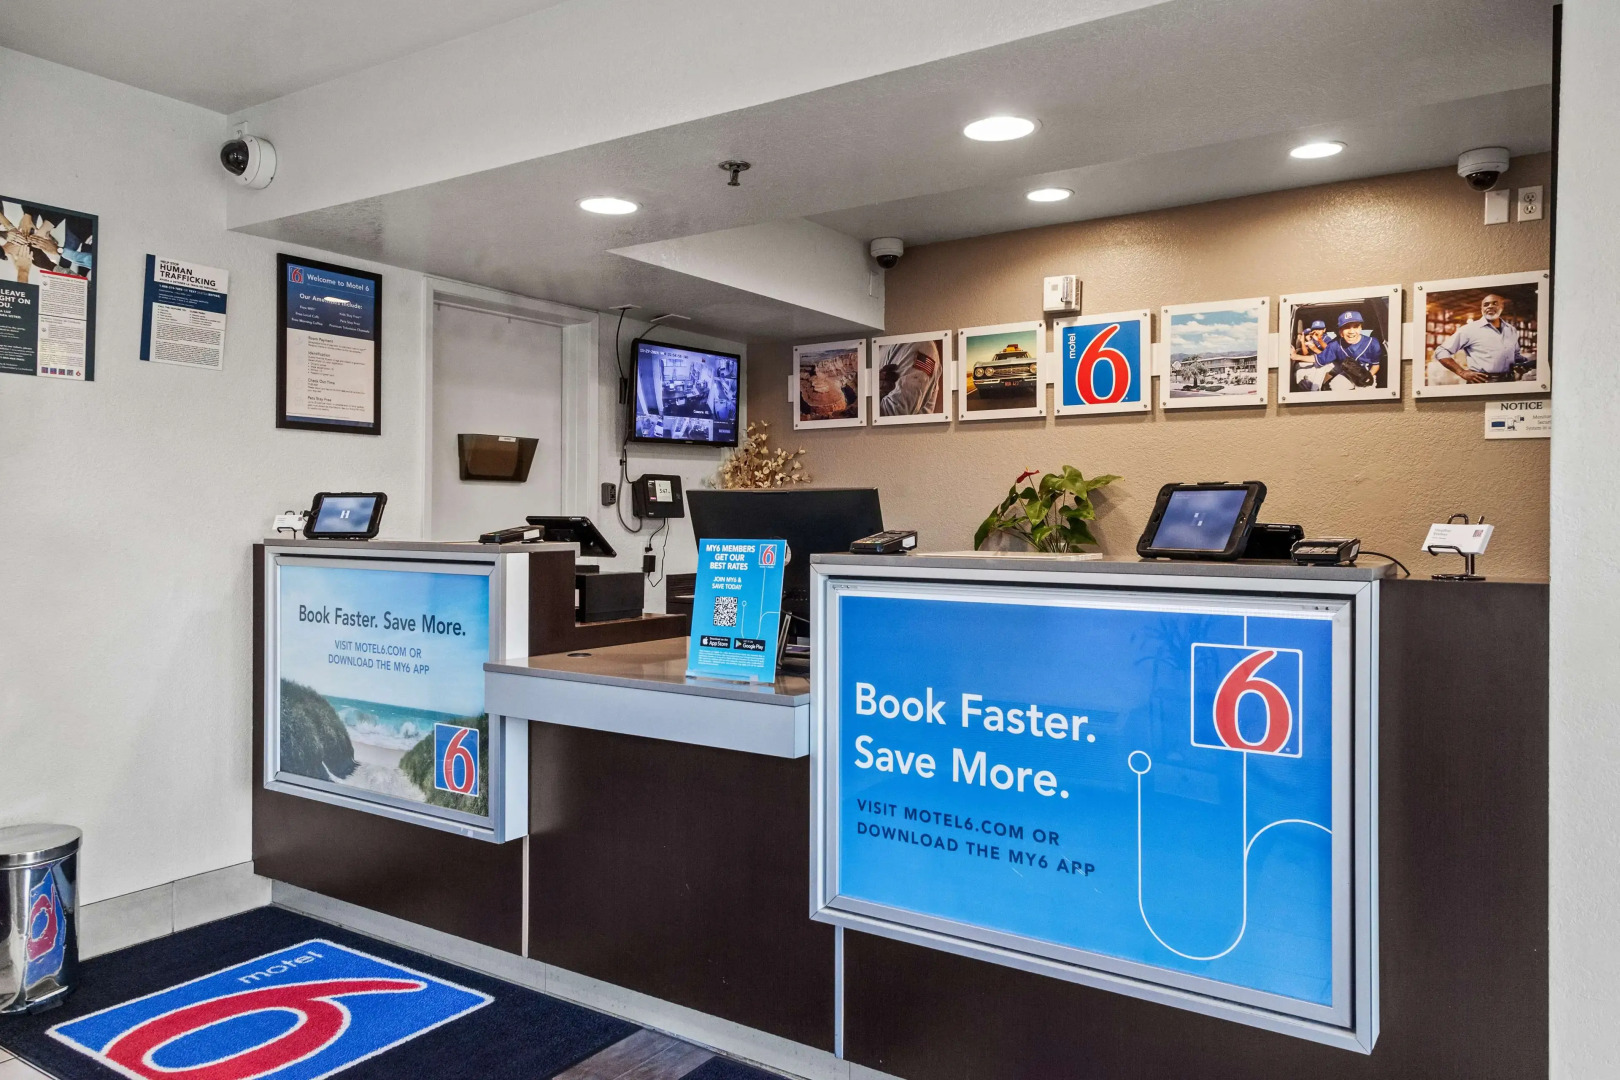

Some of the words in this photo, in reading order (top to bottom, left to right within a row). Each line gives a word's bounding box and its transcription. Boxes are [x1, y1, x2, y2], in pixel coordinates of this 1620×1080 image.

[160, 264, 192, 275] HUMAN
[160, 271, 216, 286] TRAFFICKING
[307, 273, 336, 285] Welcome
[346, 282, 363, 291] Motel
[0, 289, 25, 297] LEAVE
[1076, 323, 1131, 405] 6
[1501, 402, 1543, 411] NOTICE
[728, 562, 748, 570] RATES
[762, 545, 775, 565] 6
[298, 604, 330, 624] Book
[334, 607, 377, 629] Faster.
[383, 611, 416, 632] Save
[422, 614, 466, 636] More.
[328, 654, 373, 668] DOWNLOAD
[376, 659, 391, 670] THE
[393, 661, 411, 673] MY6
[413, 664, 429, 675] APP
[334, 639, 352, 650] VISIT
[354, 641, 407, 657] MOTEL6.COM
[409, 647, 421, 659] OR
[855, 681, 946, 727] Book
[961, 693, 1097, 743] Faster.
[1212, 648, 1293, 753] 6
[443, 728, 475, 794] 6
[854, 734, 936, 779] Save
[952, 748, 1070, 798] More.
[856, 798, 897, 817] VISIT
[904, 805, 1024, 840] MOTEL6.COM
[1033, 828, 1060, 846] OR
[857, 822, 959, 851] DOWNLOAD
[965, 841, 1000, 860] THE
[1008, 848, 1049, 869] MY6
[1056, 856, 1096, 877] APP
[236, 949, 324, 984] motel
[99, 977, 428, 1080] 6
